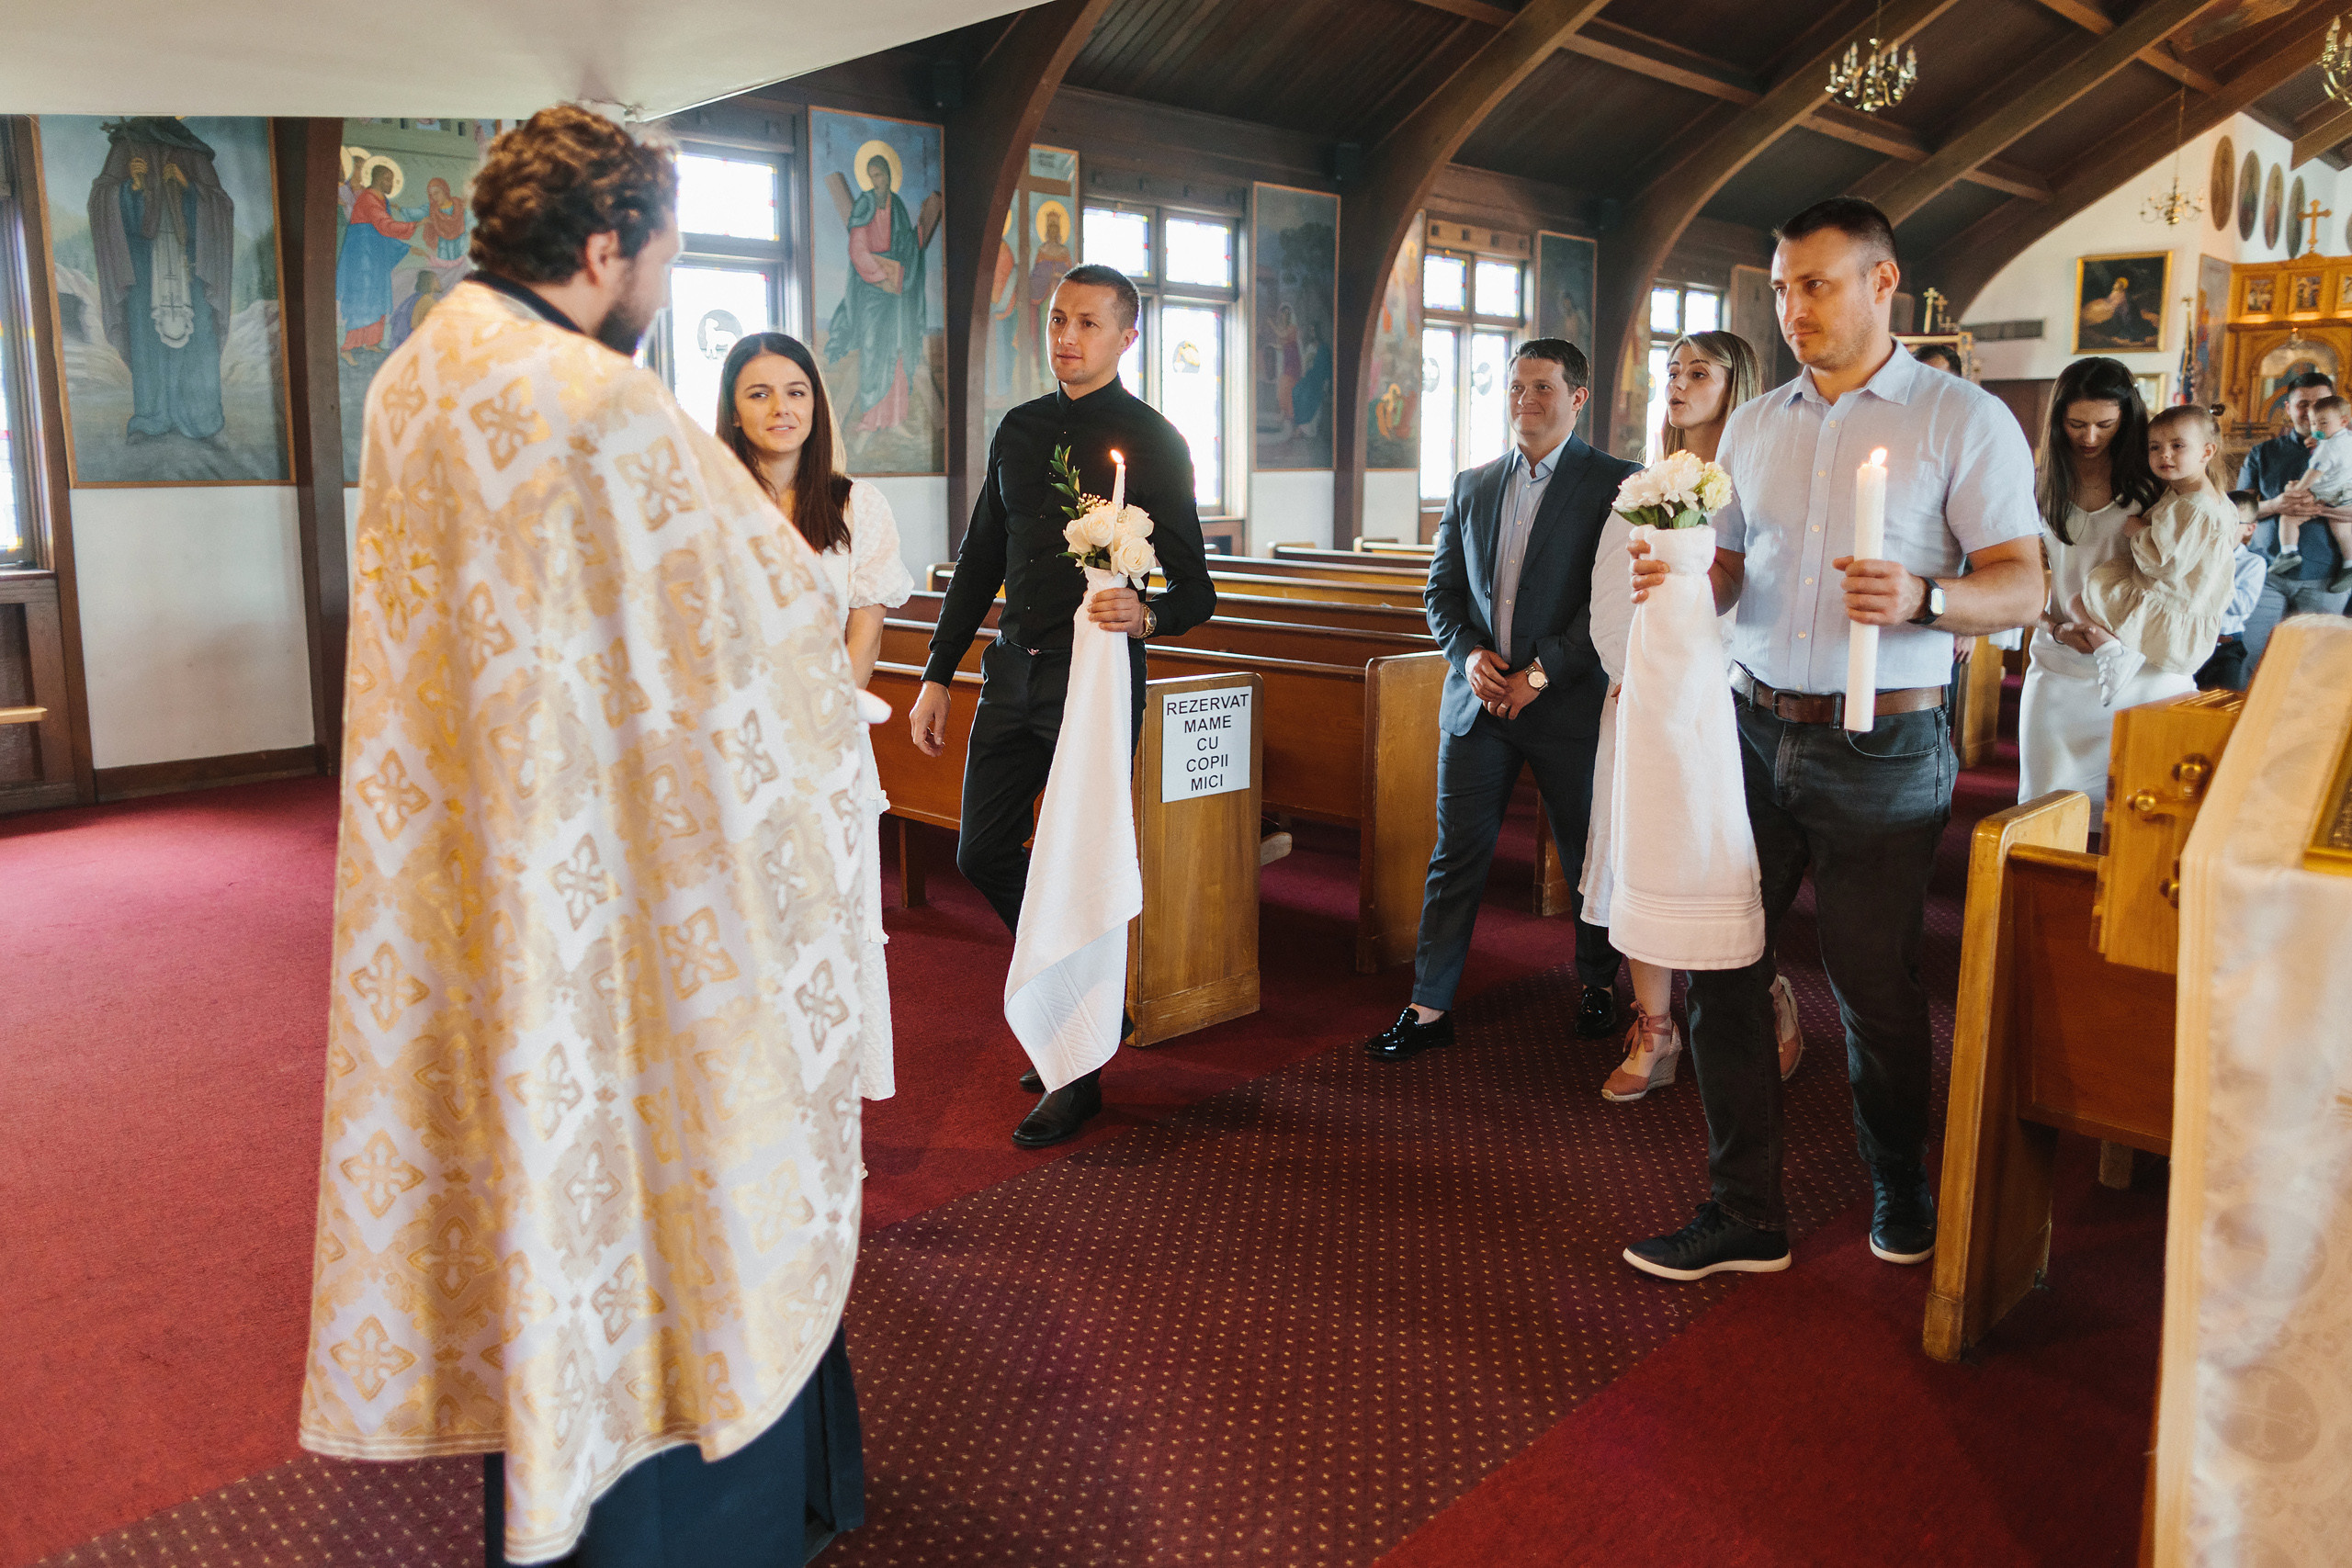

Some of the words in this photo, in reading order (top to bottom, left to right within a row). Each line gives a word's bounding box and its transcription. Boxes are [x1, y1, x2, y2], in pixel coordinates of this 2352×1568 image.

[1167, 694, 1249, 716] REZERVAT
[1184, 715, 1231, 733] MAME
[1197, 736, 1218, 750] CU
[1186, 754, 1228, 772] COPII
[1191, 773, 1223, 791] MICI
